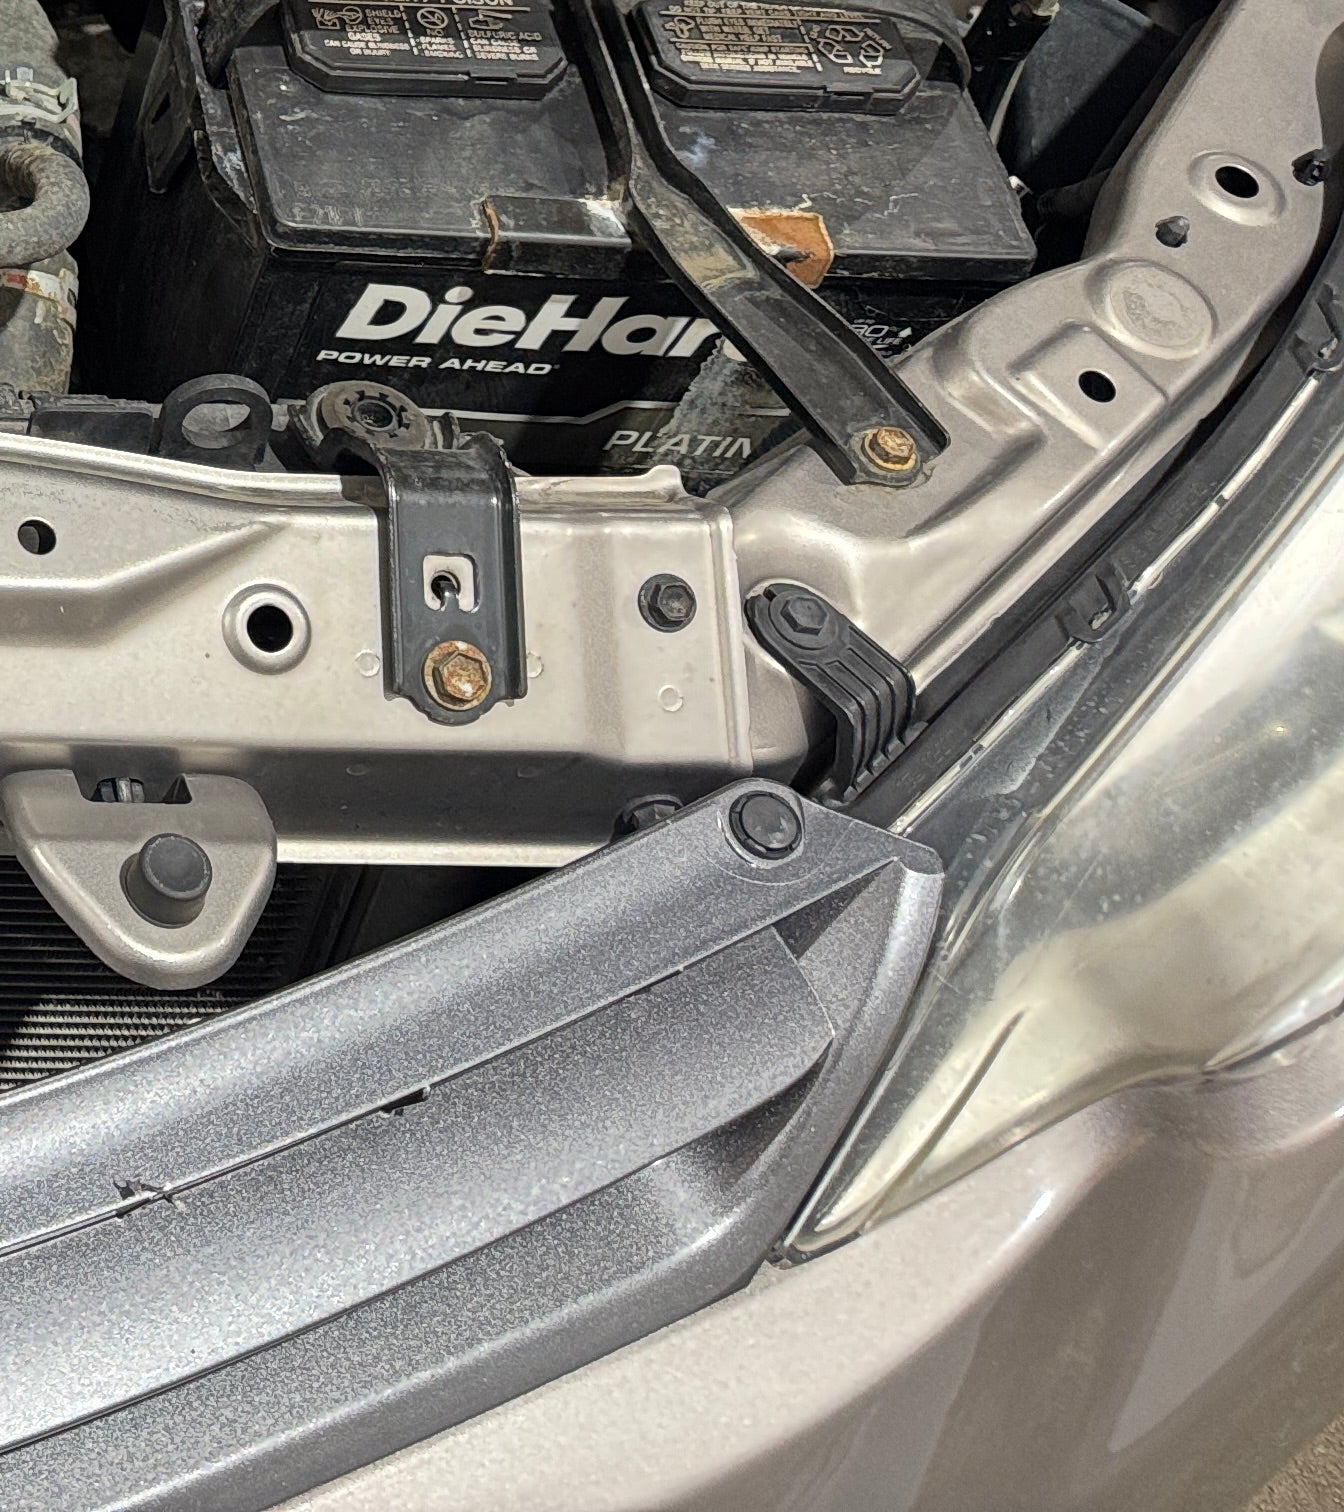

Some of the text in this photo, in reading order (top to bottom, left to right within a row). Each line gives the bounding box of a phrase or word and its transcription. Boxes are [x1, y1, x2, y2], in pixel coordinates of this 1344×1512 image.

[345, 24, 400, 34] EXPLOSIVE
[426, 28, 445, 37] NO
[467, 29, 542, 41] SULFURIC ACID
[334, 283, 749, 362] DieHar
[316, 349, 553, 376] POWER AHEAD
